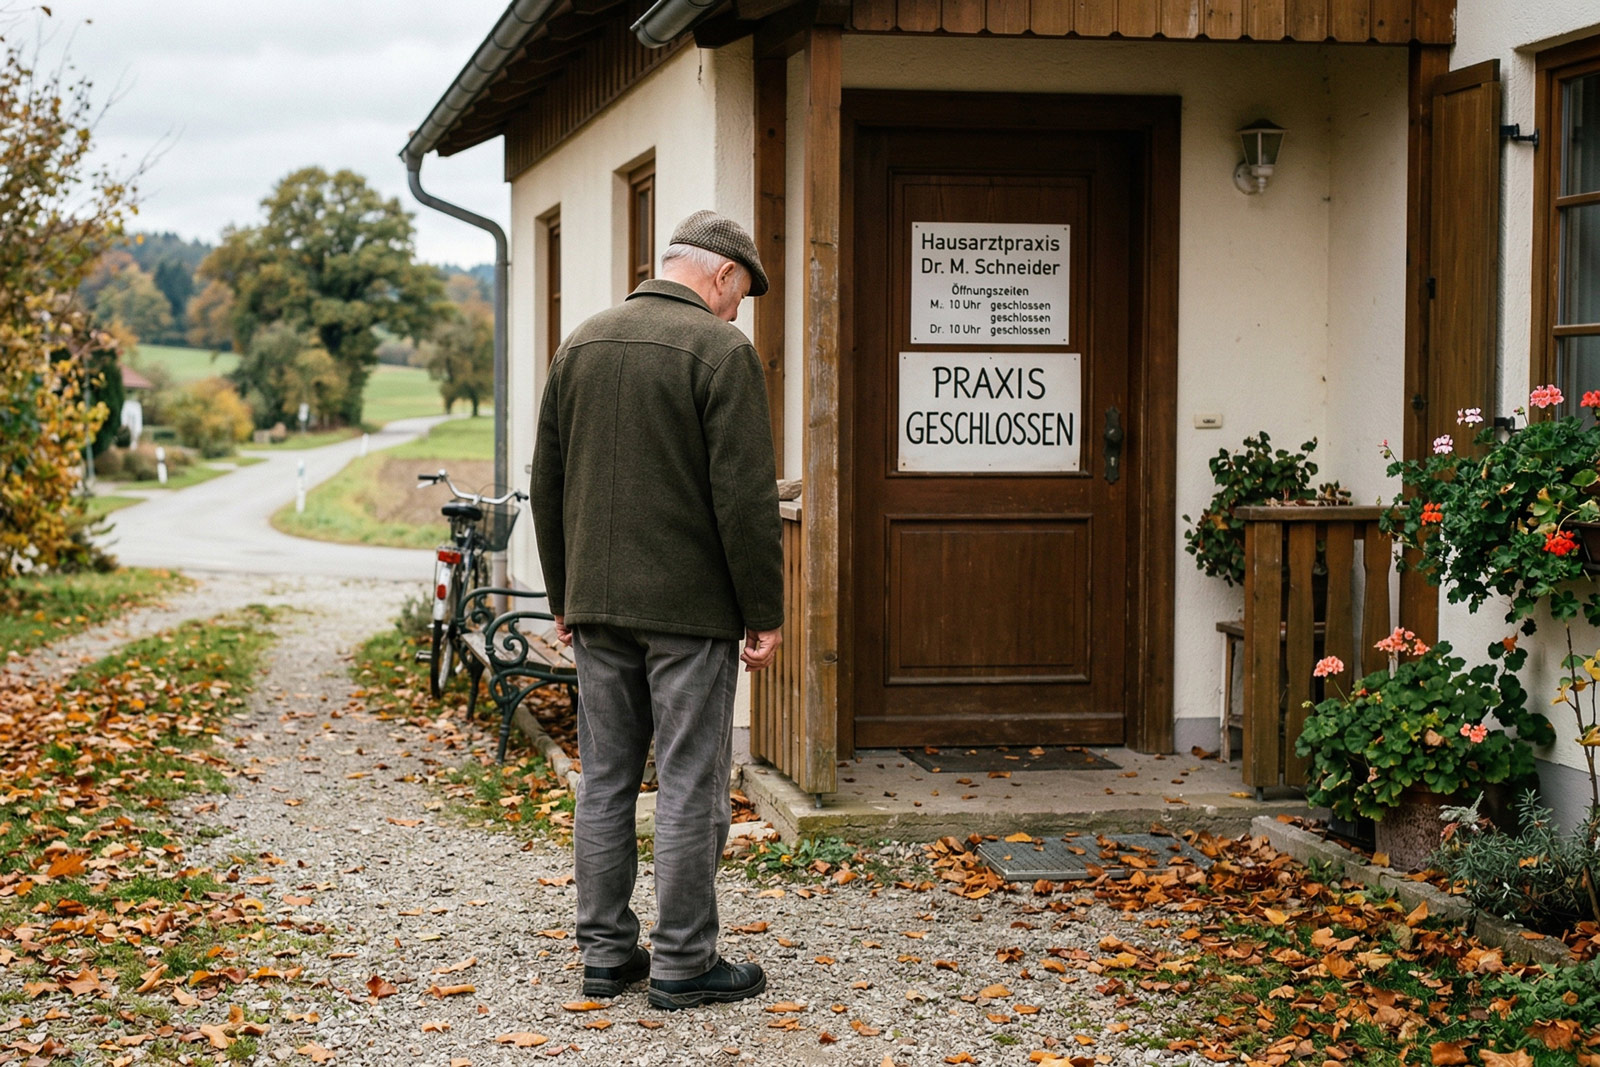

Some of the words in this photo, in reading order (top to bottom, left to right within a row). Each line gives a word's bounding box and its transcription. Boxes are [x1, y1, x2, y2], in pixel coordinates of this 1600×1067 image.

[921, 233, 1060, 255] Hausarztpraxis
[921, 258, 945, 274] Dr.
[950, 258, 969, 274] M.
[975, 259, 1061, 276] Schneider
[951, 283, 1029, 298] Öffnungszeiten
[949, 300, 961, 310] 10
[962, 300, 982, 310] Uhr
[990, 300, 1051, 312] geschlossen
[990, 312, 1051, 325] geschlossen
[930, 324, 944, 334] Dr.
[949, 324, 961, 334] 10
[962, 324, 982, 335] Uhr
[990, 325, 1051, 337] geschlossen
[932, 366, 1046, 400] PRAXIS
[906, 411, 1074, 446] GESCHLOSSEN
